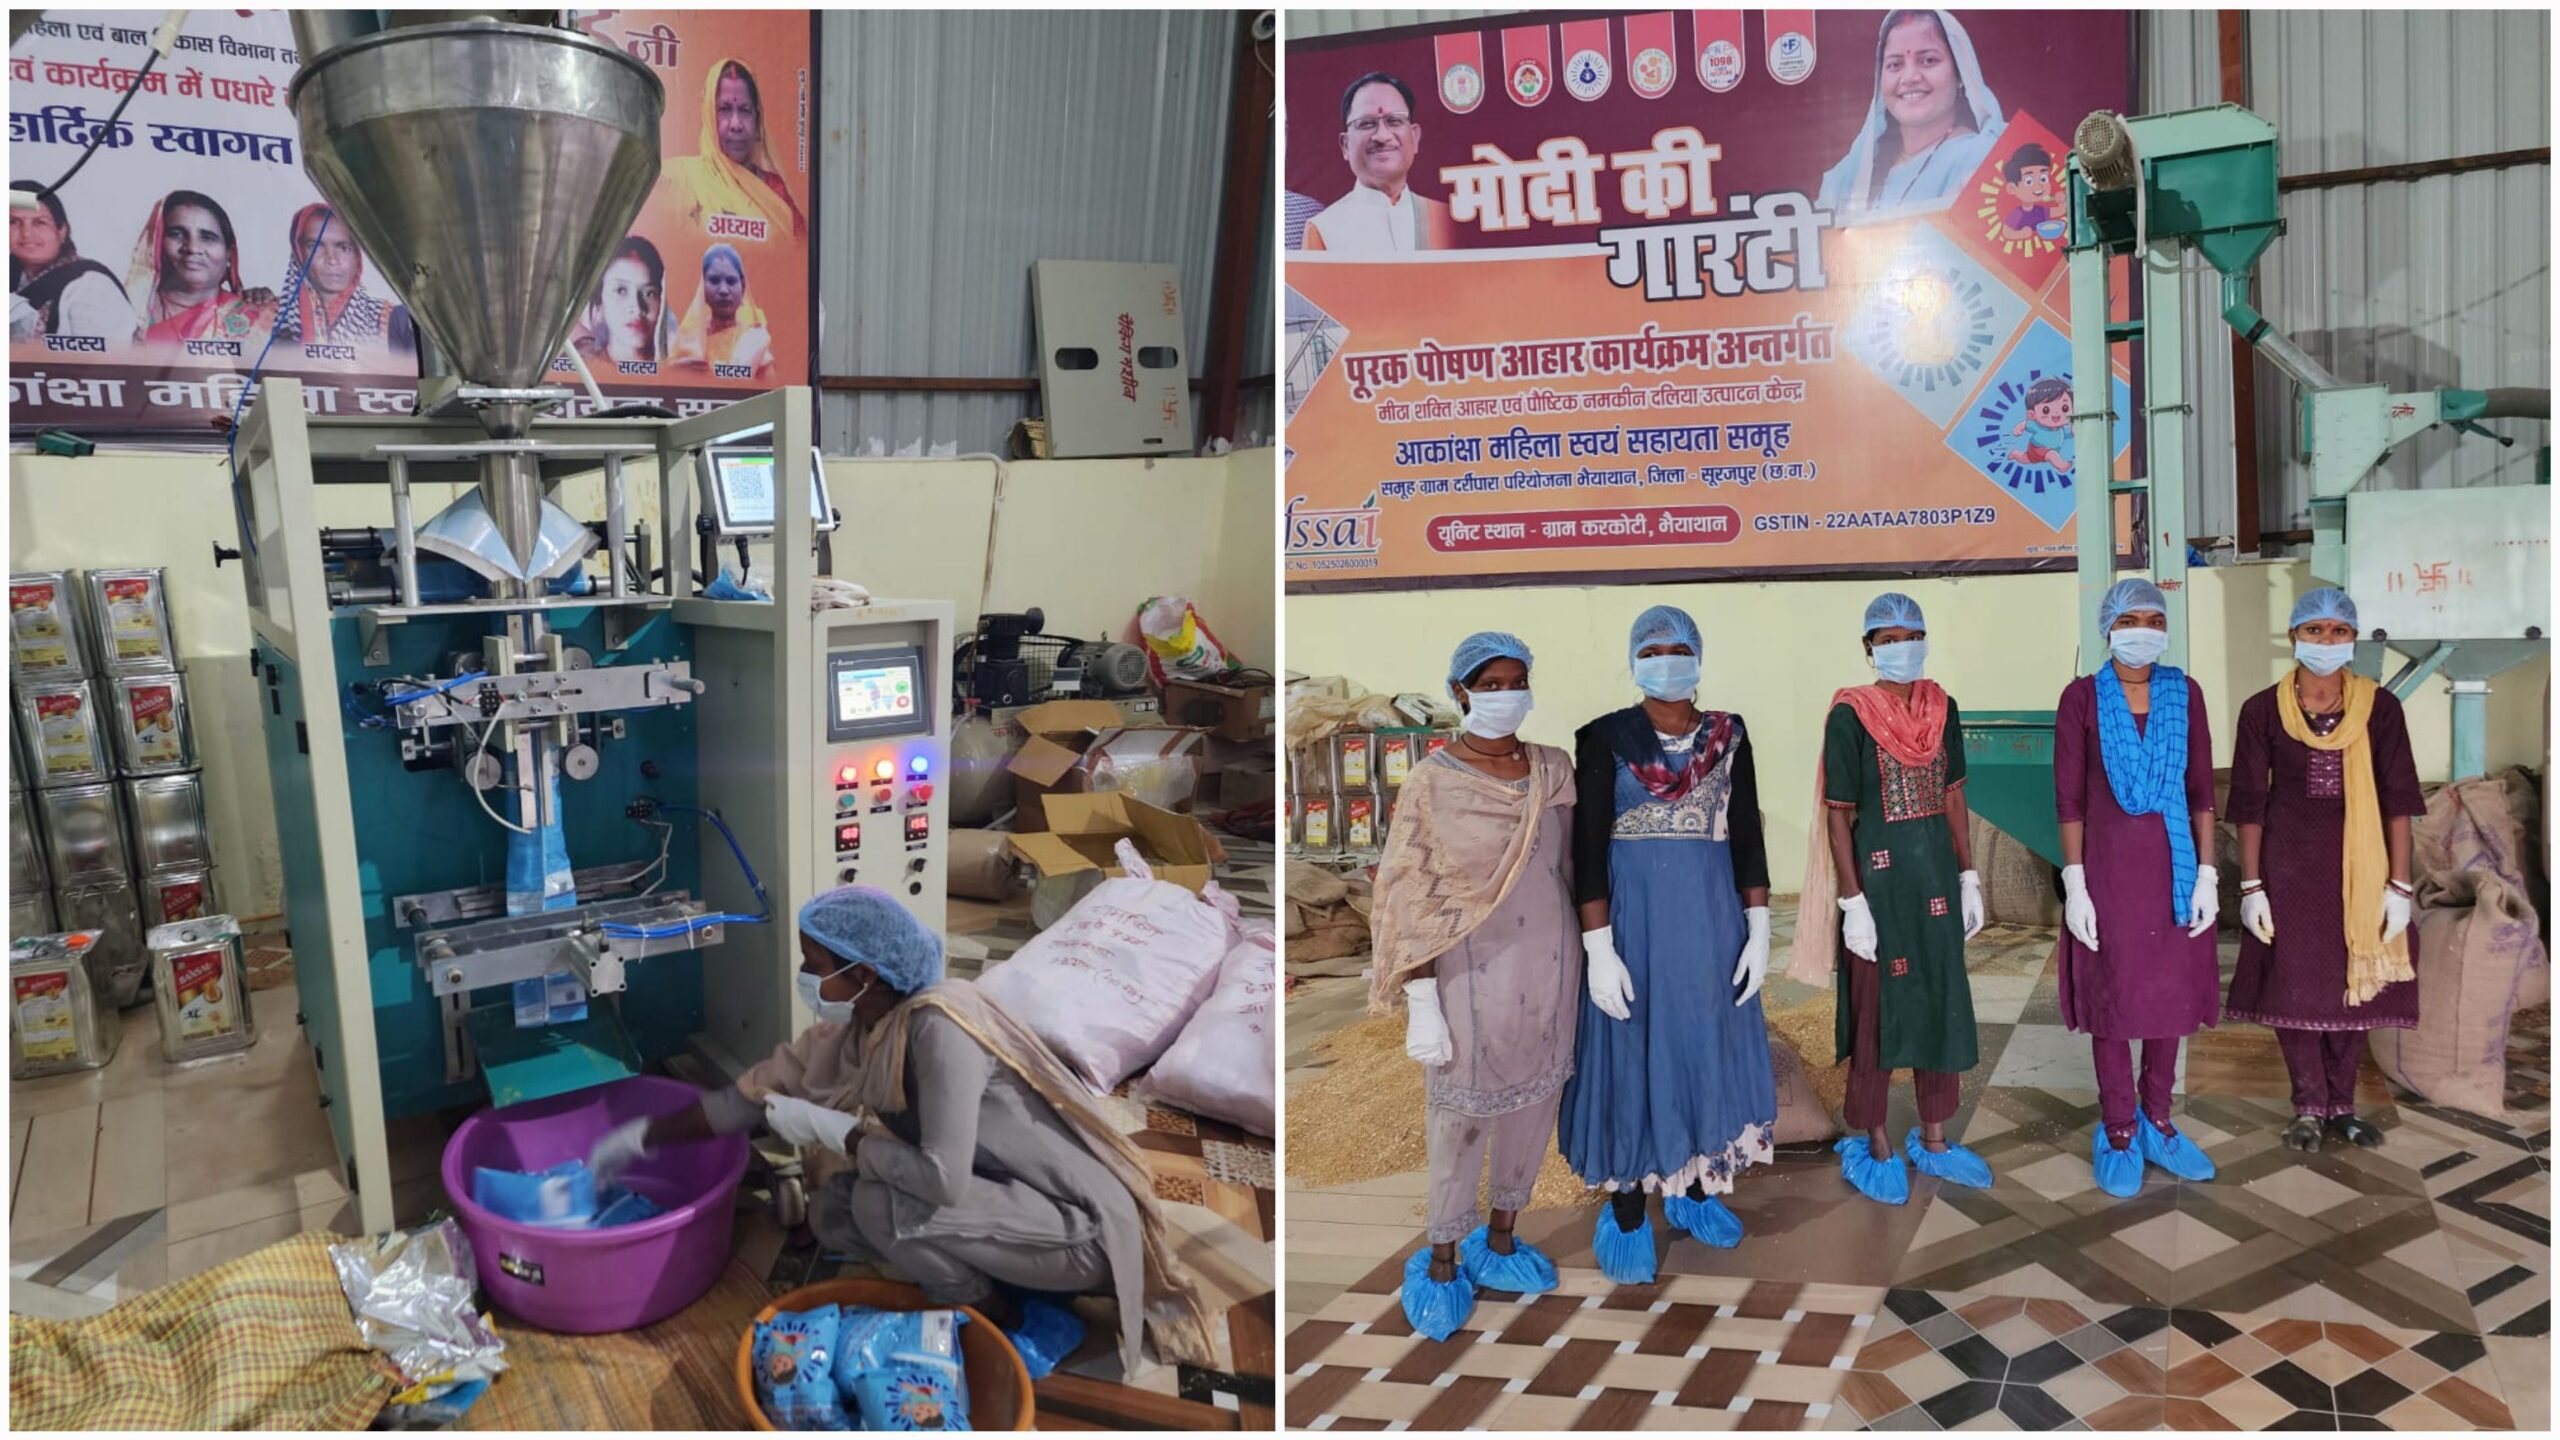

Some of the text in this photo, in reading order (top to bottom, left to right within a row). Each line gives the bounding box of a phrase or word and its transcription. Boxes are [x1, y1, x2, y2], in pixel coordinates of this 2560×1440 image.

[76, 23, 105, 42] एवं
[110, 27, 148, 46] बाल
[218, 34, 276, 62] विभाग
[1709, 56, 1733, 67] 1098
[9, 54, 35, 83] वं
[42, 57, 168, 96] कार्यक्रम
[175, 66, 203, 99] में
[210, 74, 276, 107] पधारे
[146, 122, 294, 165] स्वागत
[1438, 125, 1722, 232] मोदी की
[708, 214, 767, 240] अध्यक्ष
[1598, 192, 1834, 302] गारंटी
[45, 334, 107, 354] सदस्य
[185, 339, 243, 357] सदस्य
[304, 342, 356, 361] सदस्य
[1344, 316, 1834, 400] पूरक पोषण आहार कार्यक्रम अन्तर्गत
[618, 360, 659, 375] सदस्य
[714, 364, 753, 378] सदस्य
[1377, 377, 1803, 422] मीठा शक्ति आहार एवं पौष्टिक नमकीन दलिया उत्पादन केन्द्र
[1395, 422, 1792, 466] आकांक्षा महिला स्वयं सहायता समूह
[1380, 480, 1416, 500] समूह
[1419, 479, 1449, 495] ग्राम
[1504, 468, 1573, 490] परियोजना
[1647, 464, 1686, 485] जिला
[1700, 464, 1757, 487] सूरजपुर
[1285, 496, 1382, 552] fssai
[1437, 520, 1481, 547] यूनिट
[1483, 522, 1526, 540] स्थान
[1541, 520, 1577, 538] ग्राम
[1658, 510, 1729, 535] भैयाथान
[1753, 513, 1810, 532] GSTIN
[1825, 507, 1996, 530] 22AATAA7803P1Z9
